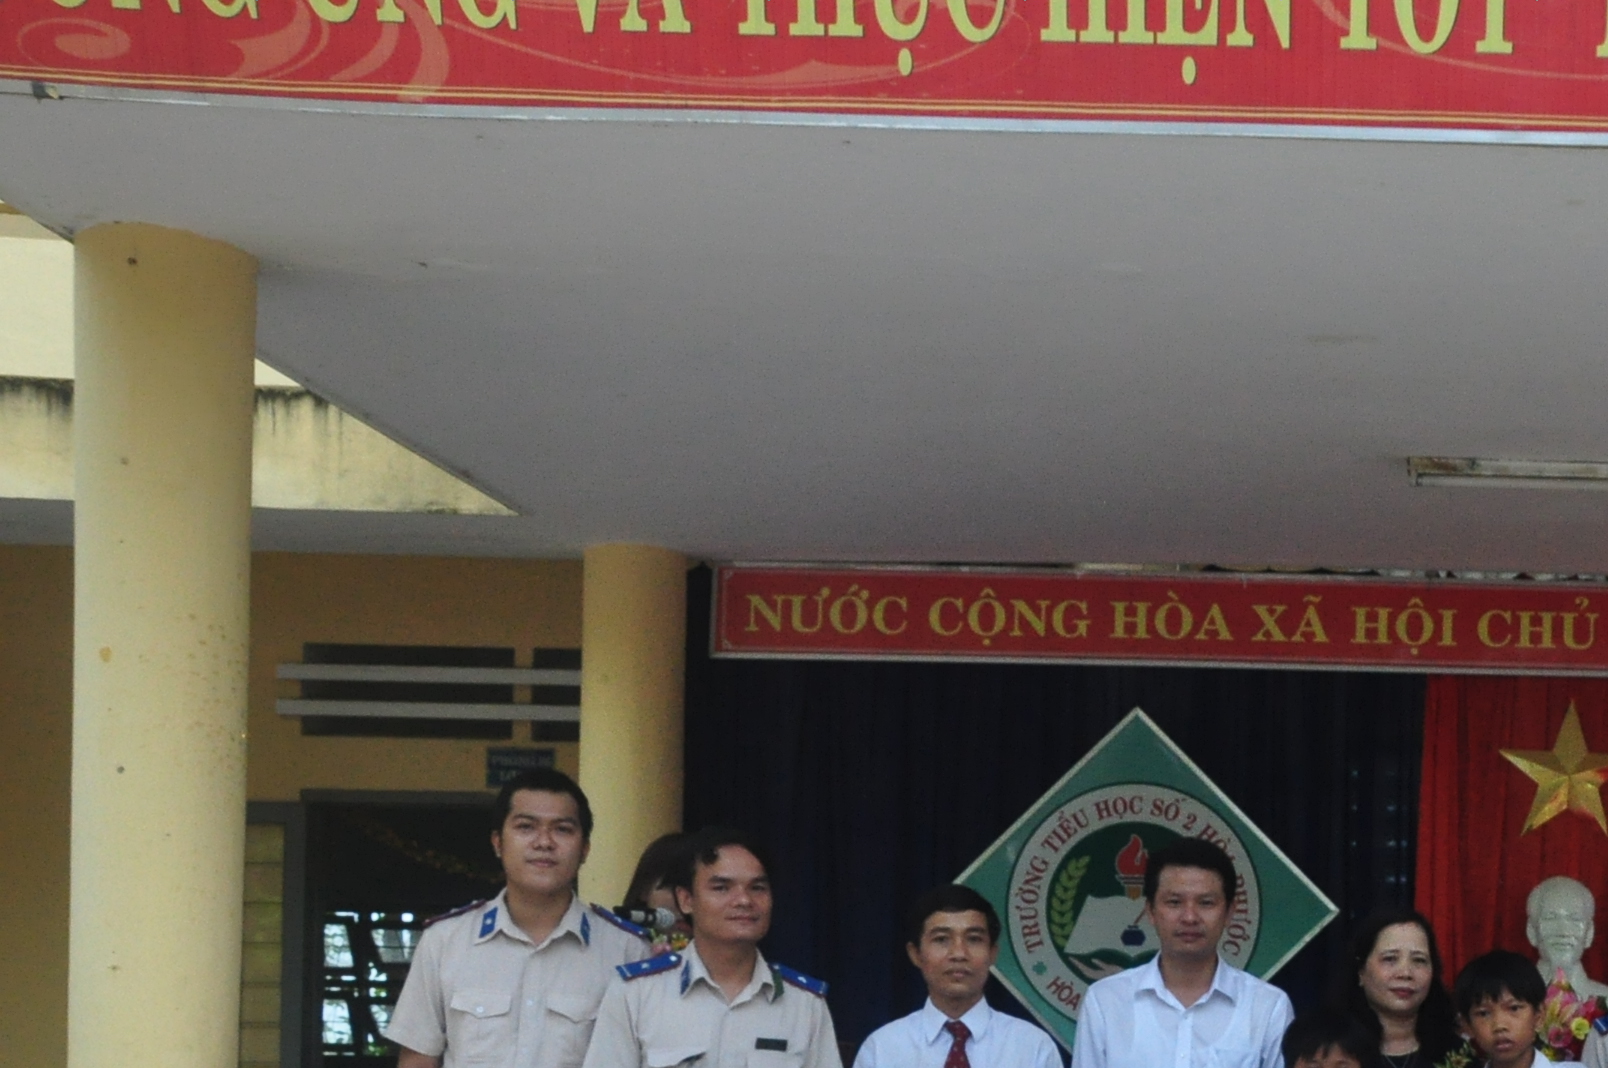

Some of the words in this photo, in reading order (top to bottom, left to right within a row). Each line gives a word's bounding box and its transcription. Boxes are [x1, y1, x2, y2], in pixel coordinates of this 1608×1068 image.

[747, 585, 908, 635] NƯỚC
[928, 588, 1090, 646] CỘNG
[1109, 591, 1233, 640] HÒA
[1252, 594, 1330, 643] XÃ
[1351, 598, 1456, 655] HỘI
[1477, 597, 1598, 650] CHỦ
[1015, 856, 1049, 953] TRƯỜNG
[1042, 809, 1089, 853] TIỂU
[1094, 796, 1143, 820] HỌC
[1150, 798, 1187, 821] SỐ
[1182, 813, 1197, 831] 2
[1198, 822, 1235, 861] HÒ
